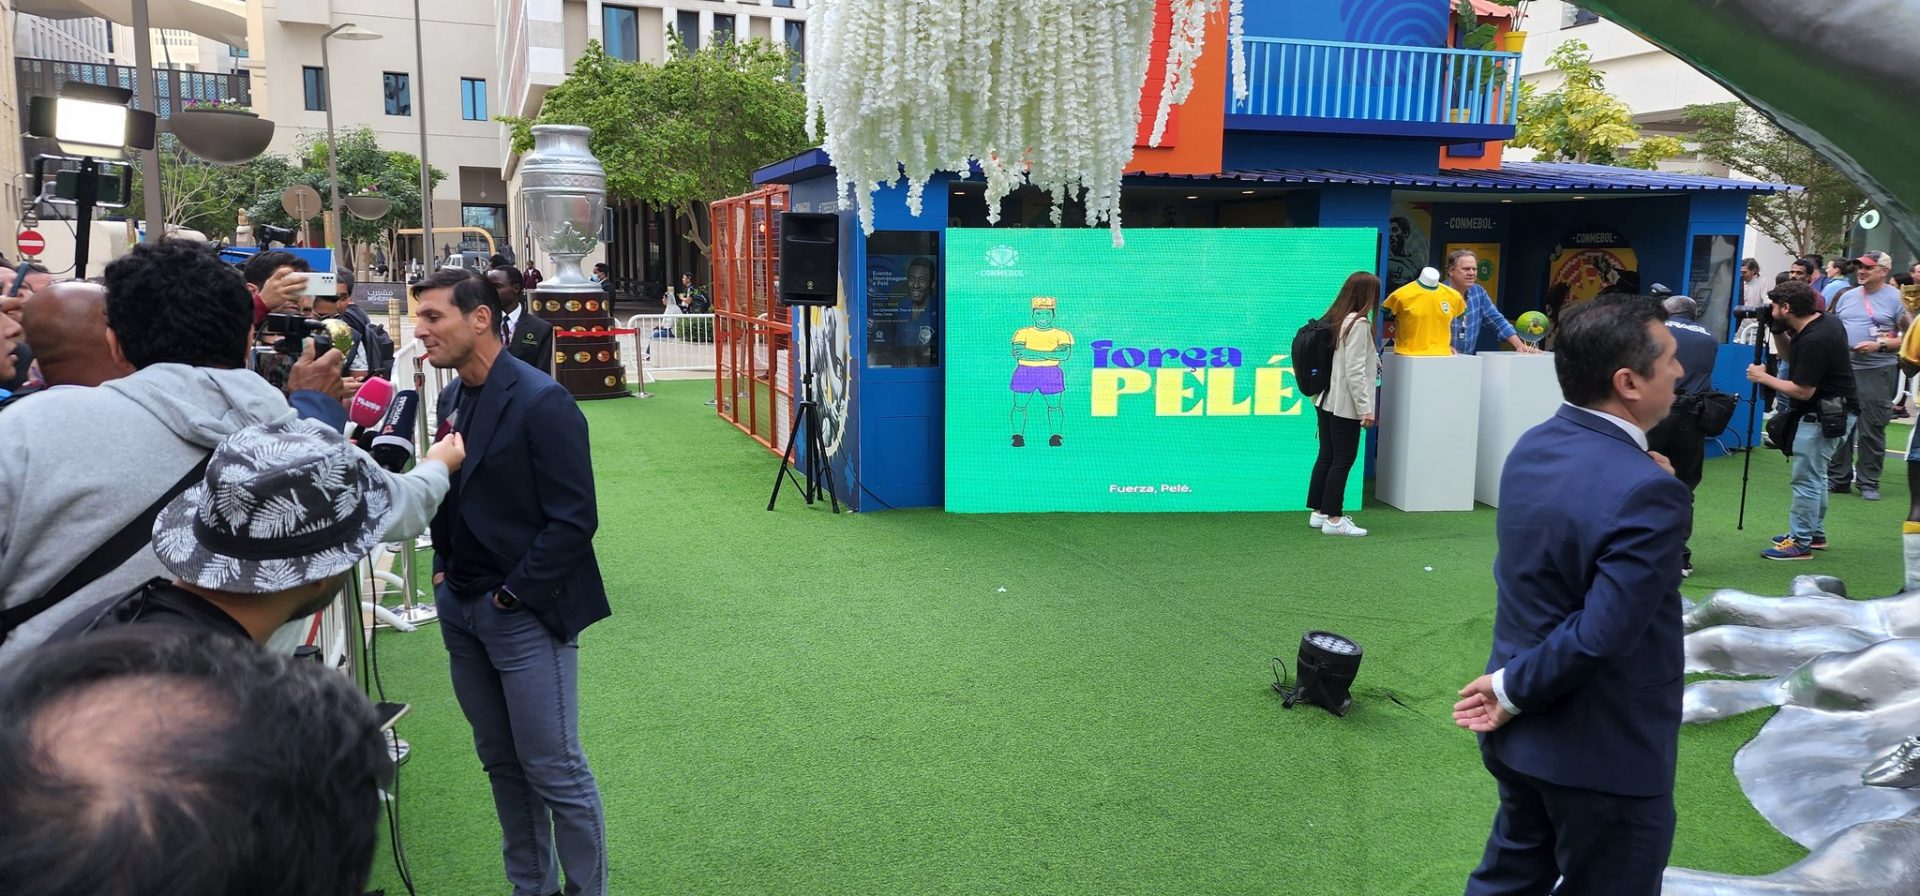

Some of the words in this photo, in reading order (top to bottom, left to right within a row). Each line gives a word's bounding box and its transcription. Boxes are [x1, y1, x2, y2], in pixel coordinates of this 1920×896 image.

[1090, 340, 1242, 371] força
[1090, 354, 1302, 417] PELÉ
[391, 395, 408, 425] NOTICIAS
[1109, 484, 1158, 494] Fuerza,
[1160, 483, 1192, 493] Pelé.
